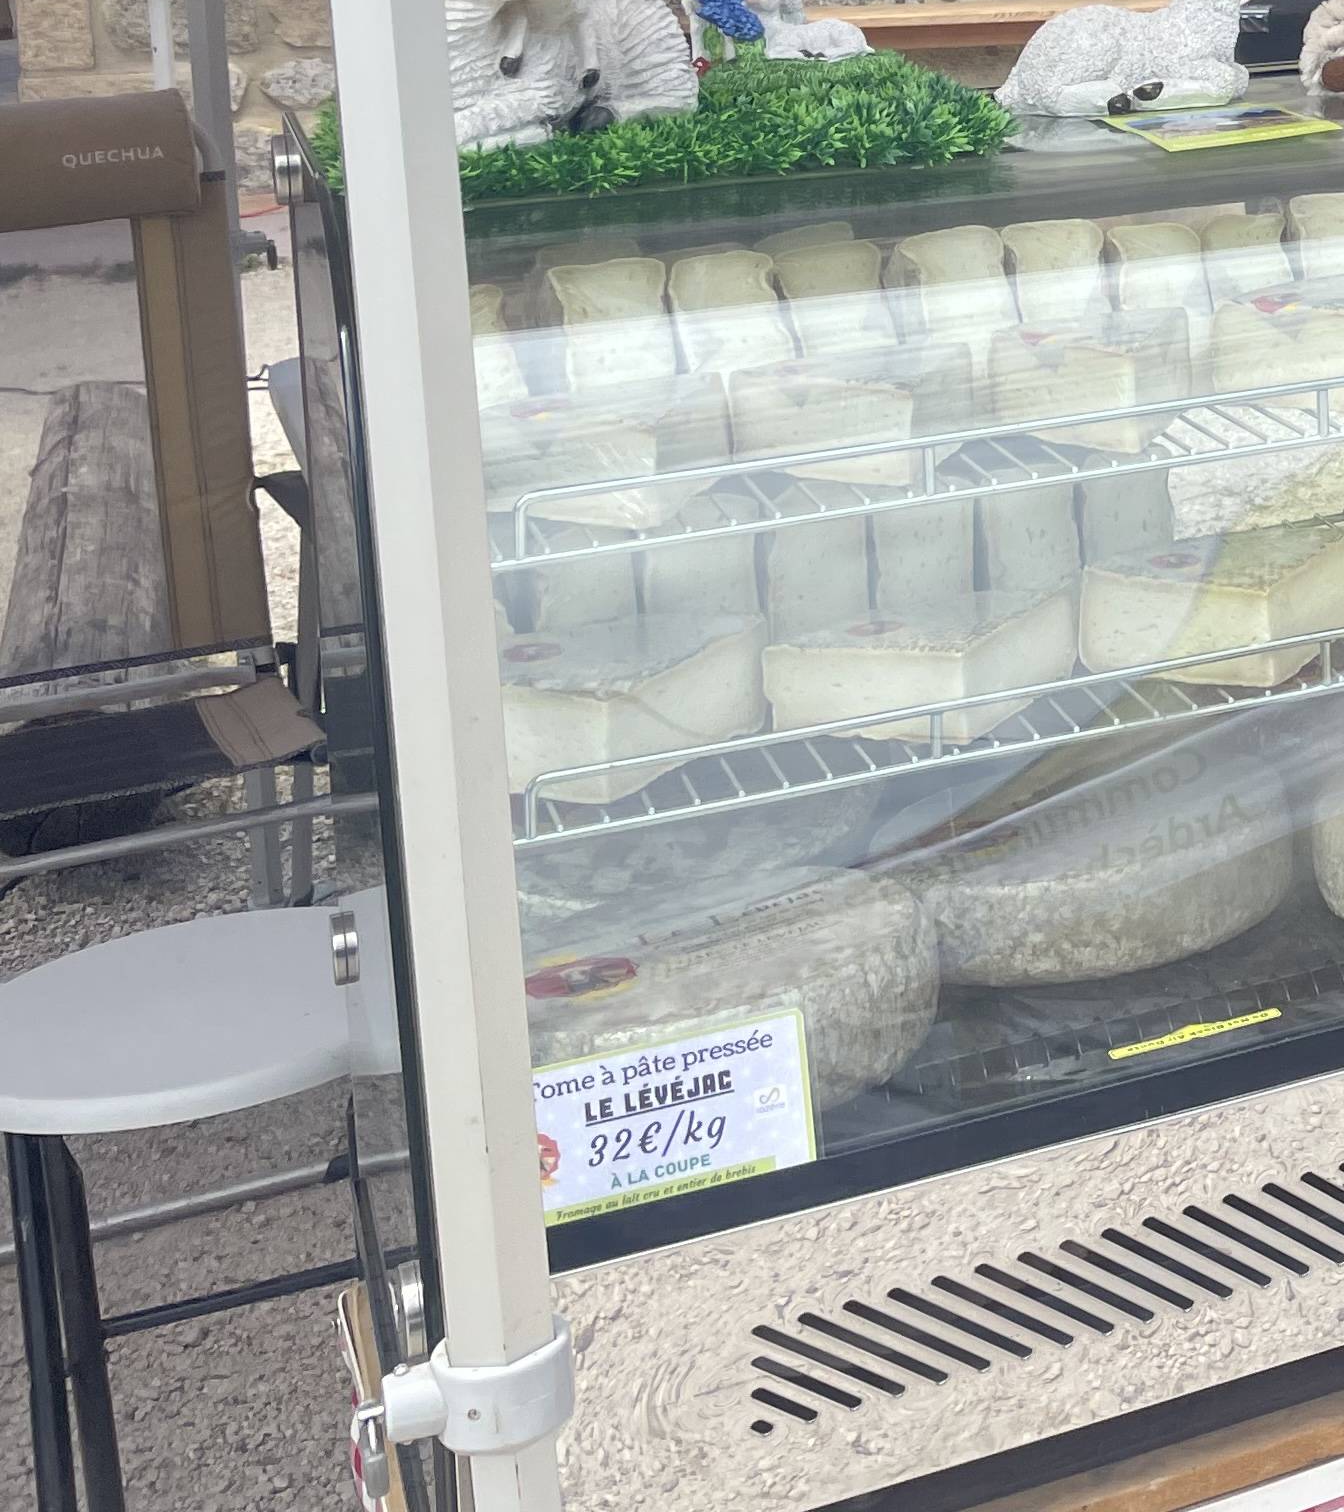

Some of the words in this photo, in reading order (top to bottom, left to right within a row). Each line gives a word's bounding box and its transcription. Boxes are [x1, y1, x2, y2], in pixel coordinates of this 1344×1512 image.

[62, 145, 164, 169] QUECHUA
[601, 1065, 616, 1087] à
[622, 1055, 676, 1087] pâte
[682, 1029, 774, 1073] pressée
[585, 1096, 613, 1123] LE
[624, 1069, 733, 1114] LÉVÉJAC
[588, 1108, 727, 1167] 32€/kg
[556, 1201, 603, 1221] Fromage
[605, 1199, 619, 1211] au
[621, 1190, 640, 1208] lait
[643, 1188, 661, 1201] cru
[663, 1184, 674, 1196] et
[676, 1176, 708, 1194] entier
[710, 1172, 723, 1186] de
[725, 1164, 757, 1182] brebis
[611, 1173, 623, 1190] À
[627, 1168, 650, 1185] LA
[654, 1153, 713, 1180] COUPE
